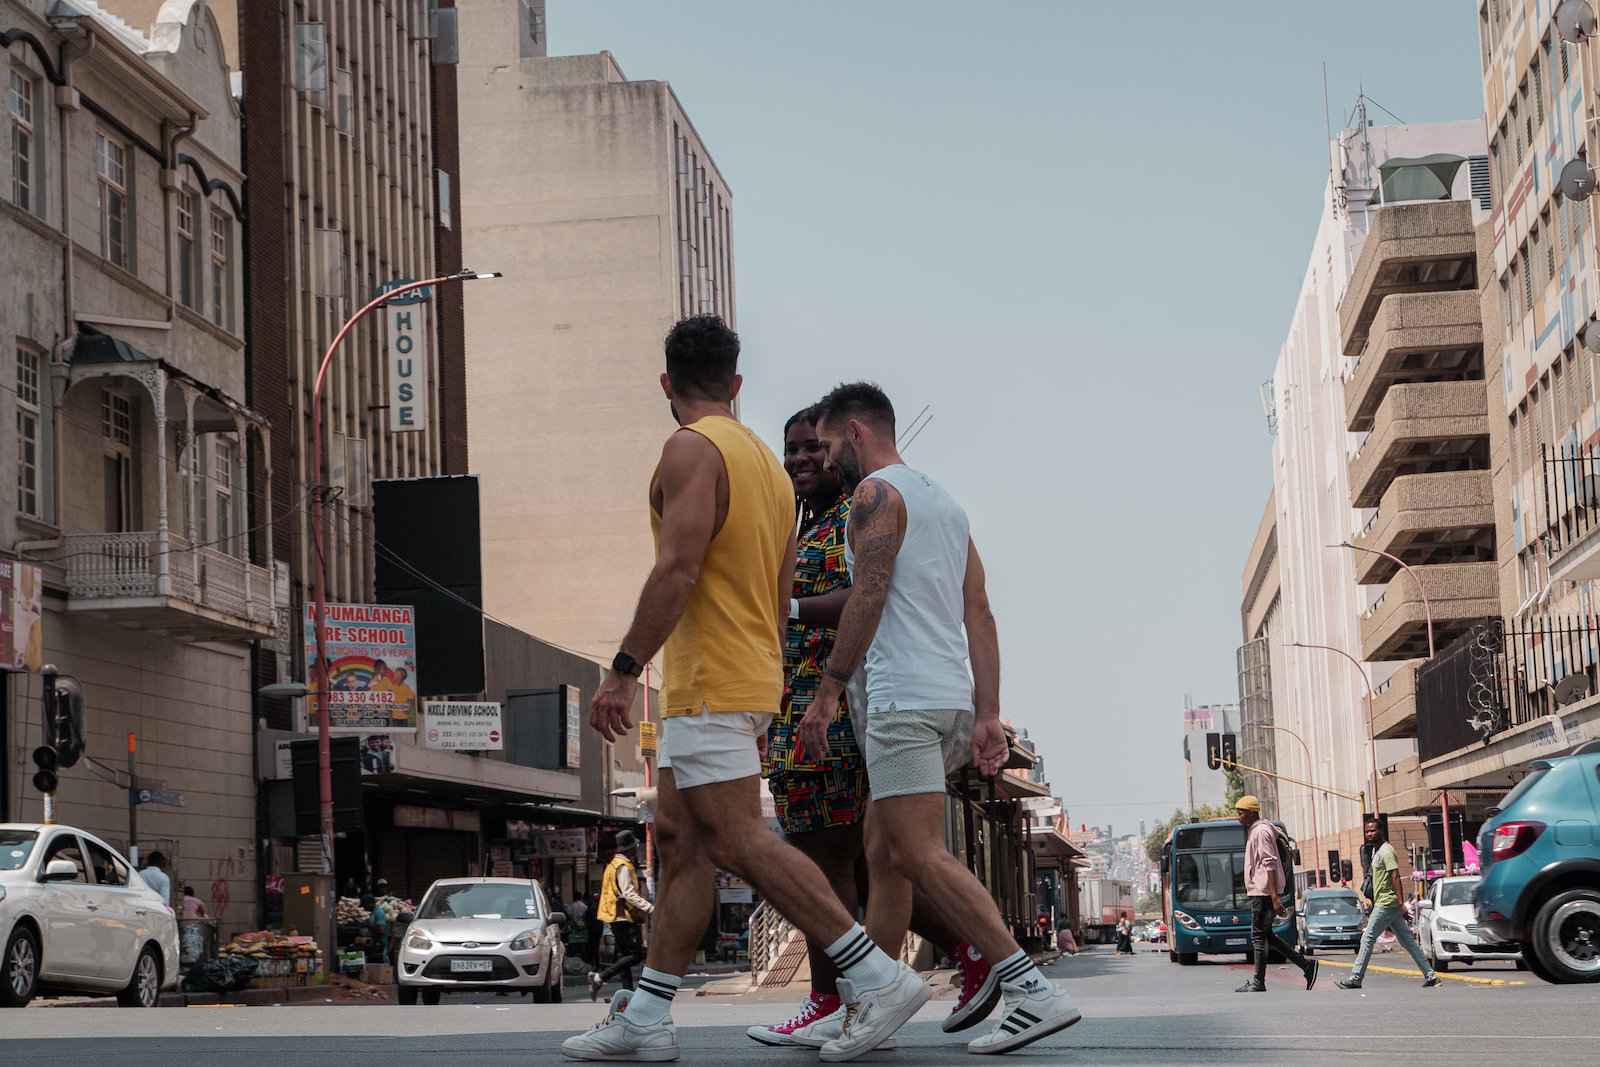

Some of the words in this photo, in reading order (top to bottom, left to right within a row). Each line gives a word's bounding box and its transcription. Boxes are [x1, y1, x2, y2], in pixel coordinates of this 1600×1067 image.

[396, 311, 414, 425] HOUSE
[348, 692, 366, 702] 330
[368, 692, 393, 702] 4182
[447, 704, 472, 717] DRIVING
[473, 705, 499, 717] SCHOOL
